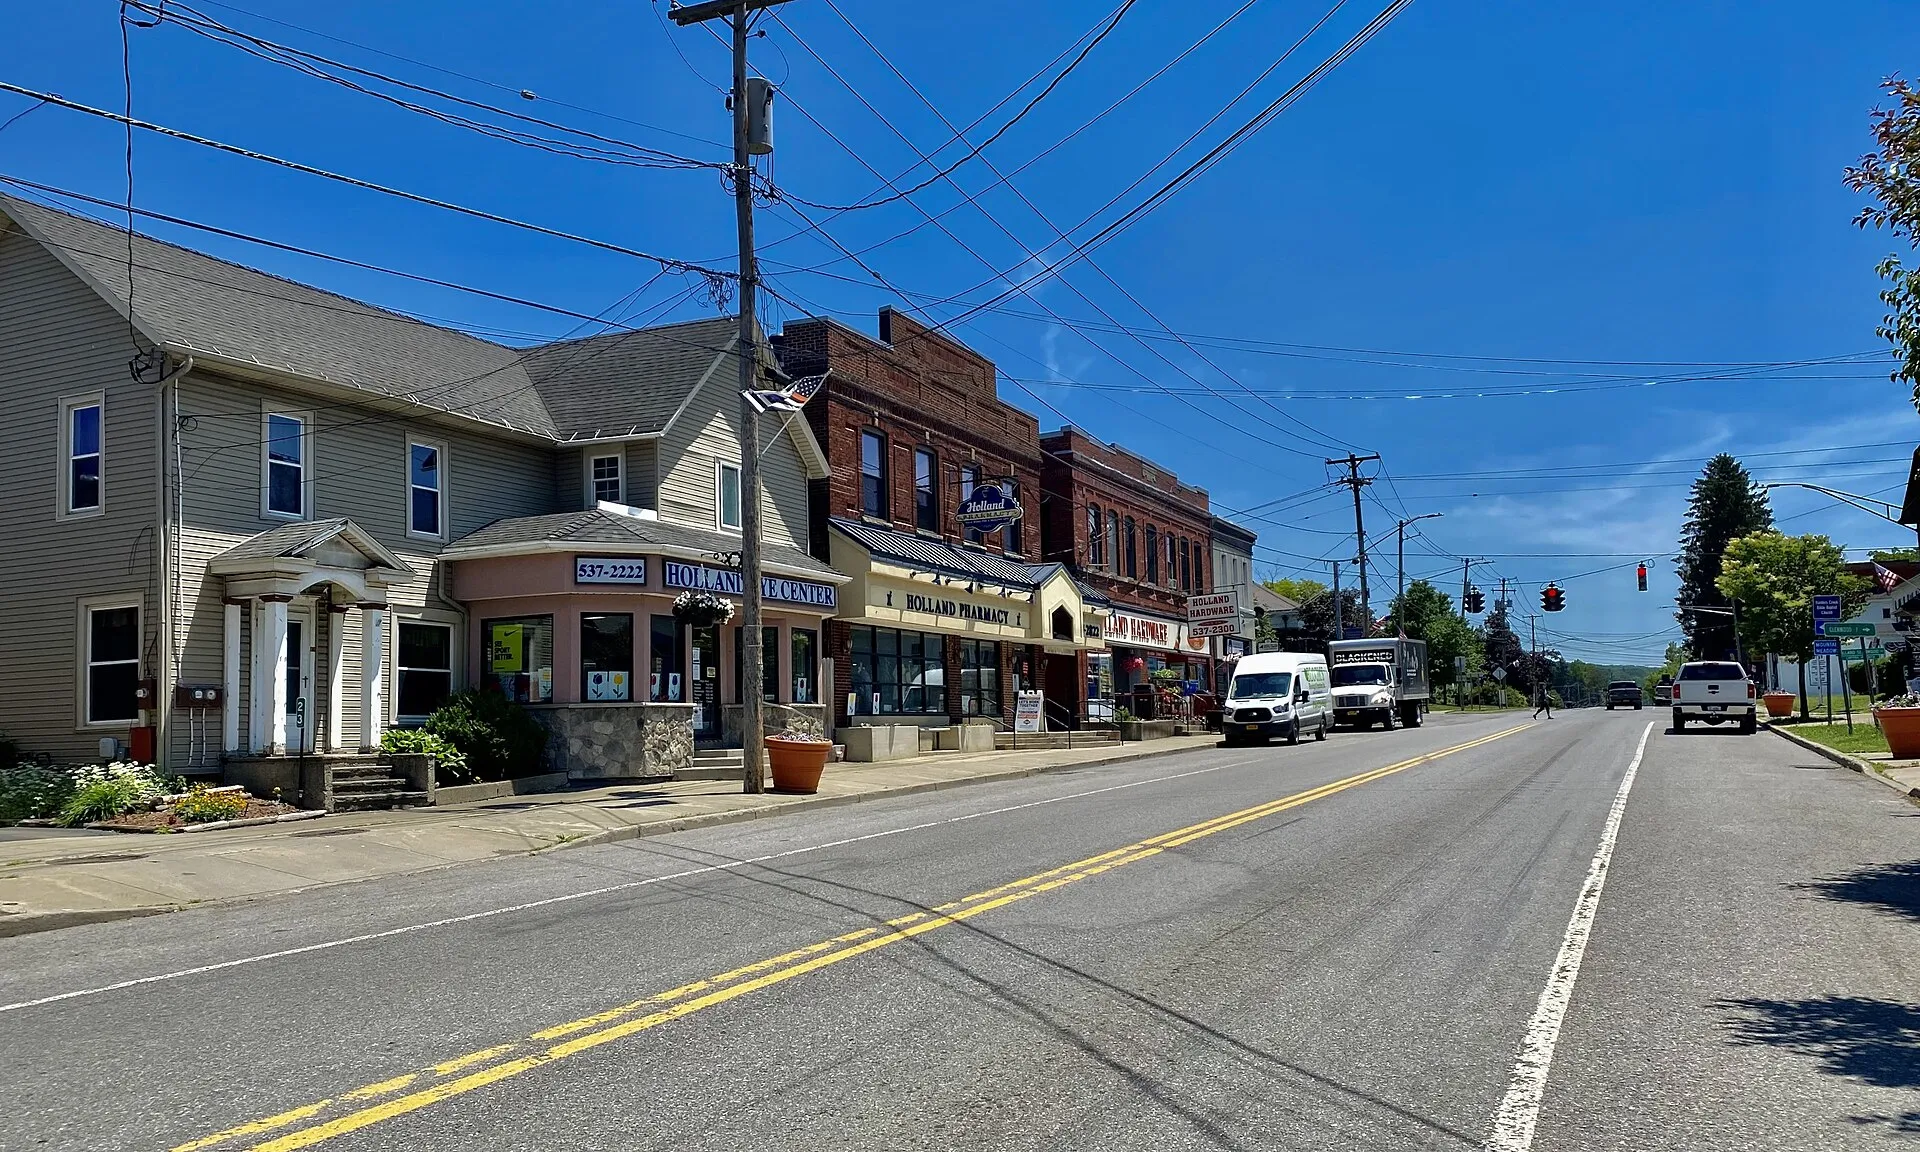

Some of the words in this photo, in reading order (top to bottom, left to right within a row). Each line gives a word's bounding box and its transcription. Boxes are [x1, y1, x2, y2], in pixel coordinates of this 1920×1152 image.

[966, 499, 1005, 512] Holland
[577, 563, 643, 579] 537-2222
[761, 577, 778, 598] YE
[781, 582, 834, 605] CENTER
[1192, 595, 1230, 607] HOLLAND
[906, 593, 956, 616] HOLLAND
[959, 602, 1009, 625] PHARMACY
[1189, 605, 1235, 618] HARDWARE
[1130, 617, 1168, 641] HARDWARE
[1192, 624, 1235, 636] 537-2300
[1336, 652, 1392, 662] BLACKENED
